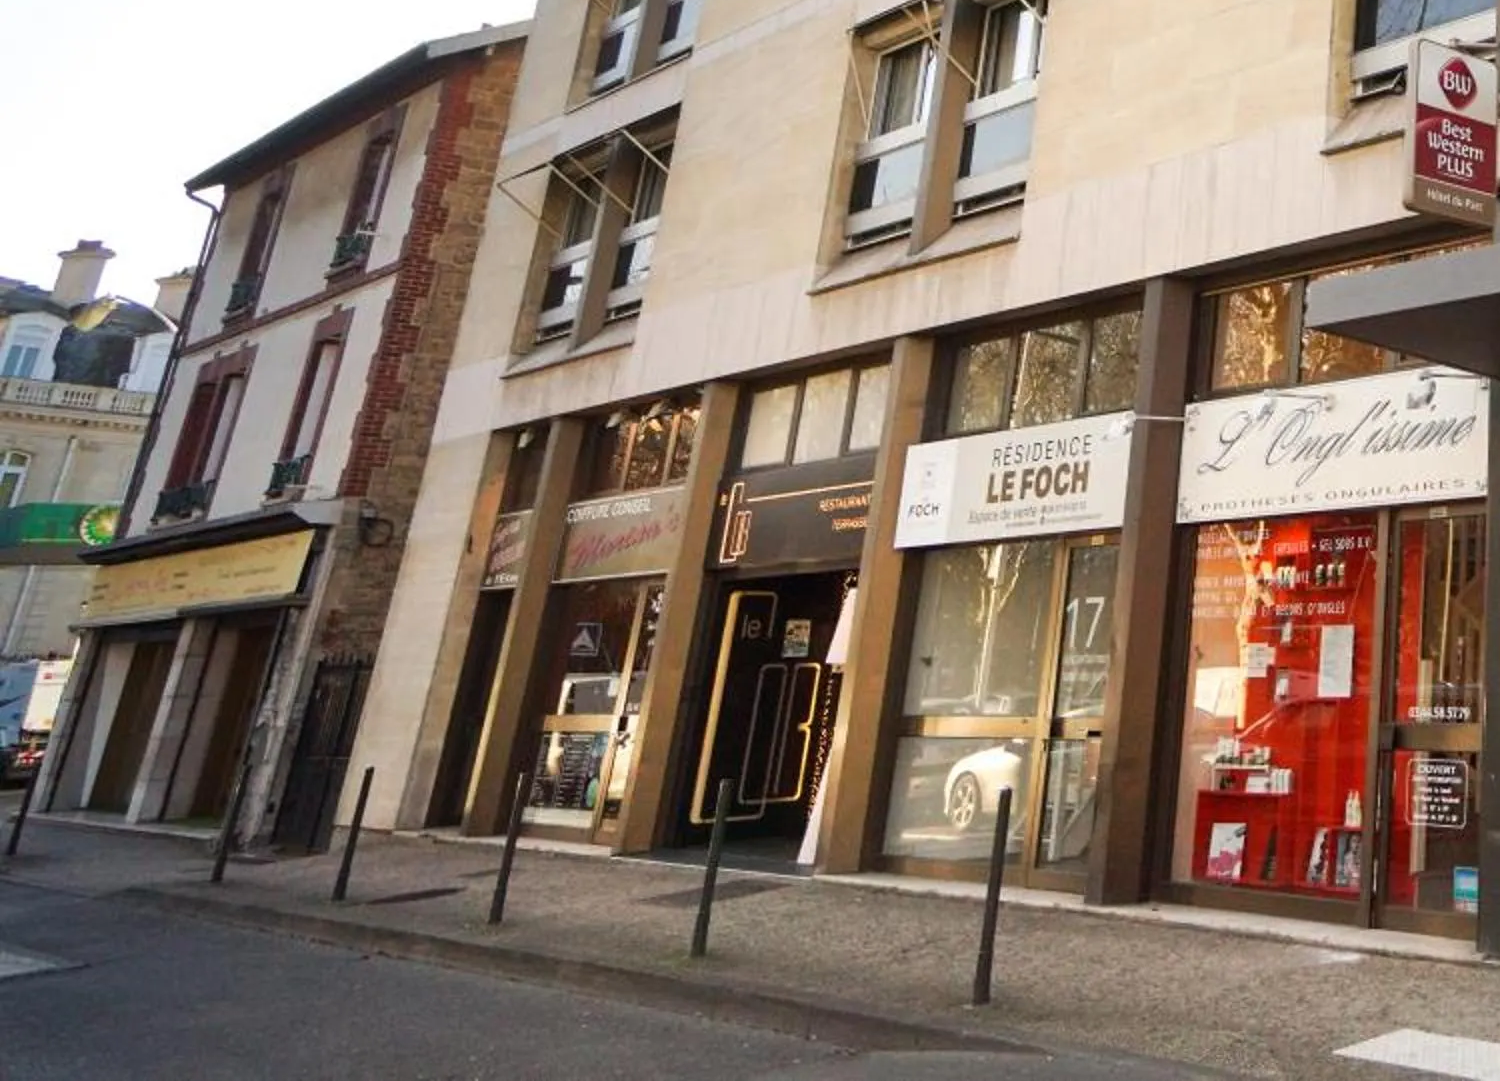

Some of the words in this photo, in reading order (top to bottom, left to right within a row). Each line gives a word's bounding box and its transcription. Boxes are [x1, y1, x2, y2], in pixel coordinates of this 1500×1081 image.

[1443, 70, 1472, 96] BW
[1441, 119, 1472, 142] Best
[1427, 132, 1485, 162] Western
[1437, 153, 1473, 178] PLUS
[992, 434, 1093, 468] RÉSIDENCE
[986, 470, 1016, 505] LE
[1020, 460, 1091, 501] FOCH
[907, 502, 940, 519] FOCH
[1066, 596, 1105, 648] 17
